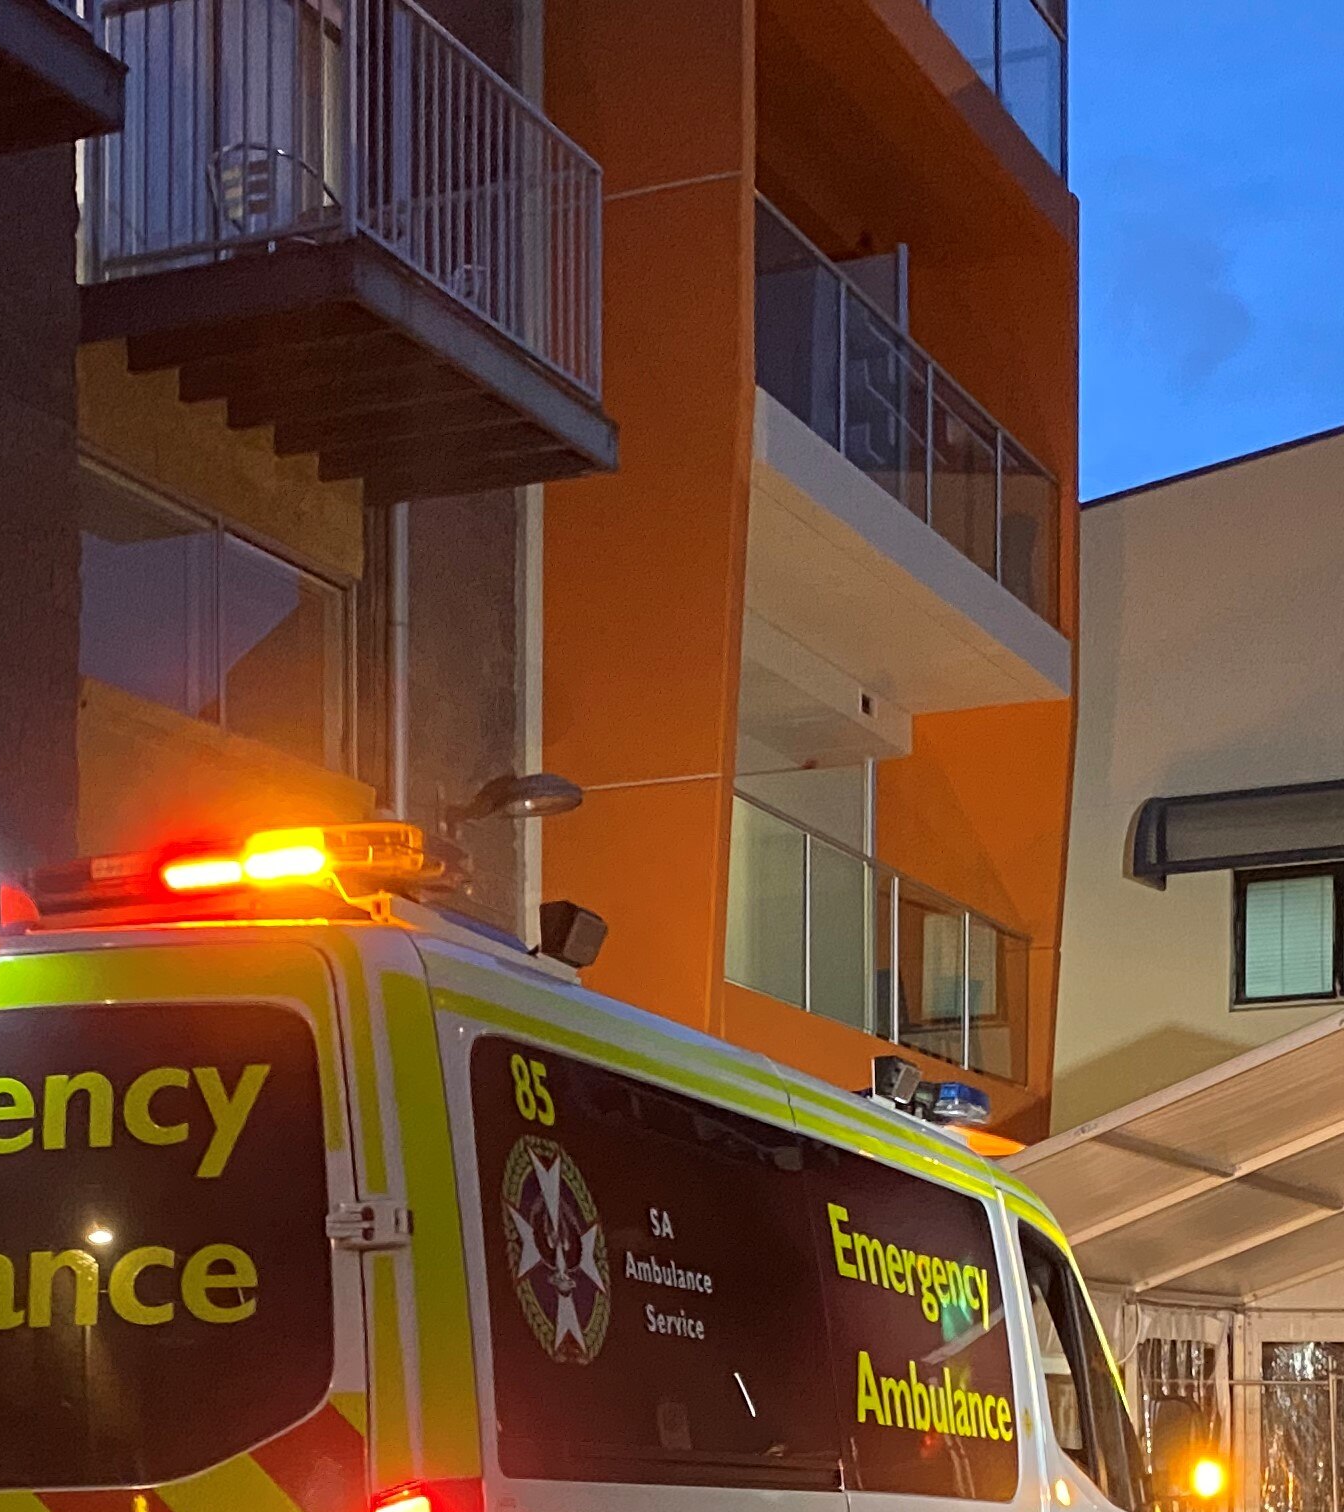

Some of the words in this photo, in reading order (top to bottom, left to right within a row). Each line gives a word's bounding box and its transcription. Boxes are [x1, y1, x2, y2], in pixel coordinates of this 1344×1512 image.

[510, 1053, 555, 1126] 85
[649, 1207, 674, 1239] SA
[625, 1251, 713, 1294] Ambulance
[827, 1202, 989, 1331] Emergency
[645, 1303, 705, 1340] Service
[857, 1350, 1014, 1442] Ambulance
